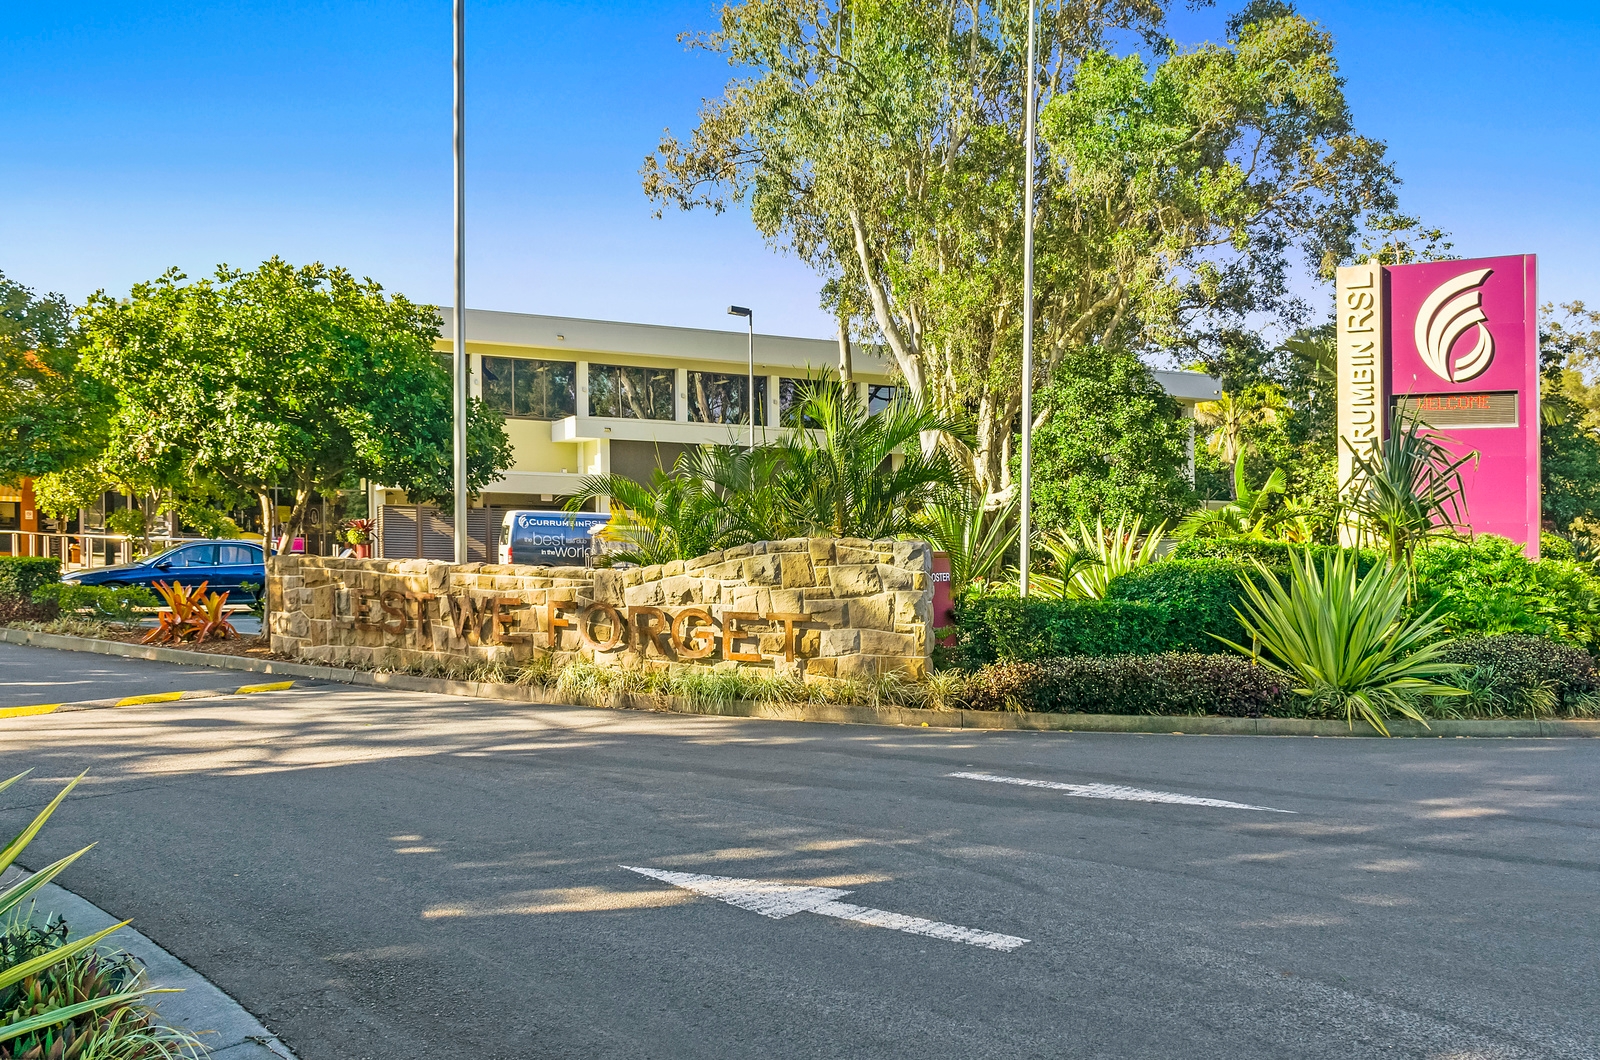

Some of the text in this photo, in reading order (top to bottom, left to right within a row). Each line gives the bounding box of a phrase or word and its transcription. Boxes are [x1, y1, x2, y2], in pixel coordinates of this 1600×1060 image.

[1346, 270, 1375, 502] RRUMBIN RSL
[1416, 396, 1490, 410] WELCOME
[533, 532, 565, 546] best
[931, 572, 950, 582] OSTER
[331, 587, 812, 663] LEST WE FORGET
